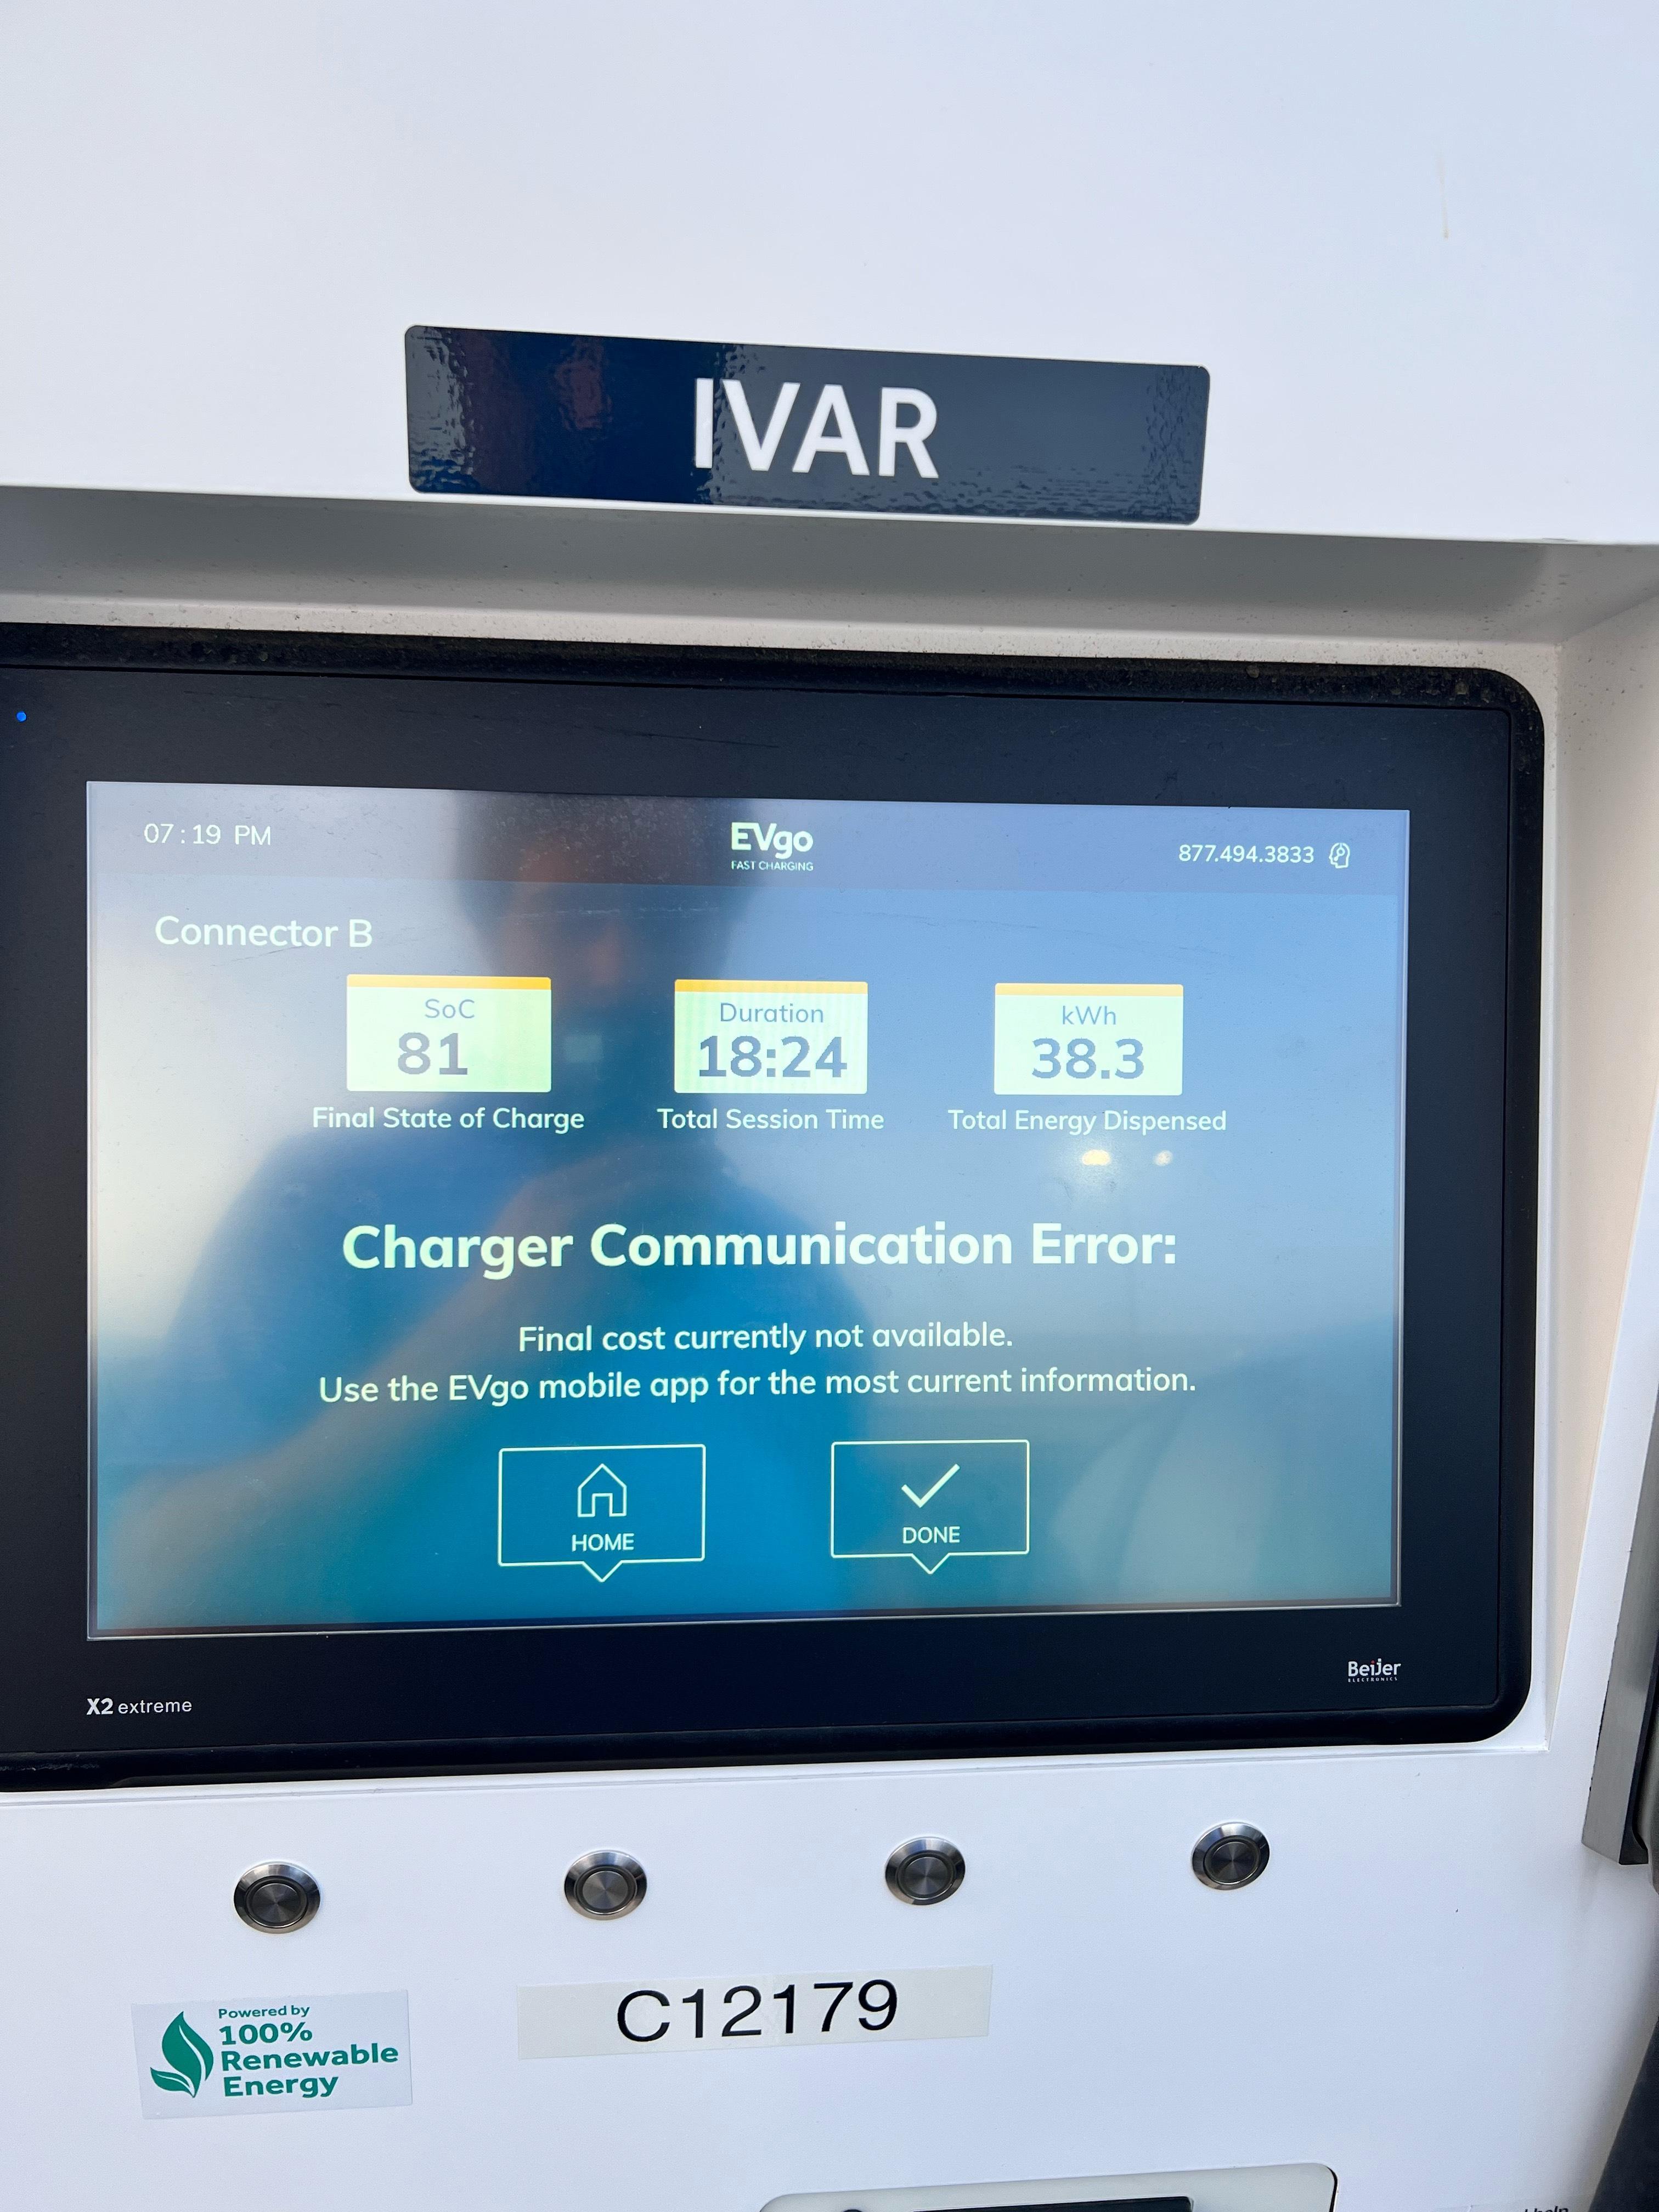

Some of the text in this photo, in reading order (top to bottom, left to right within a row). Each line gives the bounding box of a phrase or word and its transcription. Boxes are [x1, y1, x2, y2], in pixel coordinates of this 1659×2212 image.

[693, 376, 939, 479] IVAR
[234, 825, 272, 847] PM
[731, 822, 814, 859] EVgo
[731, 860, 814, 871] FAST CHARGING
[1178, 844, 1314, 864] 877.494.3833
[155, 916, 373, 948] Connector B
[424, 998, 476, 1019] SoC
[719, 1001, 825, 1024] Duration
[1062, 1005, 1117, 1026] kWh
[397, 1032, 468, 1075] 81
[698, 1036, 848, 1079] 18:24
[1032, 1038, 1146, 1080] 38.3
[313, 1107, 585, 1134] Final State of Charge
[657, 1108, 884, 1130] Total Session Time
[949, 1109, 1227, 1136] Total Energy Dispensed
[342, 1221, 1176, 1280] Charger Communication Error:
[520, 1322, 1013, 1355] Final cost currently not available.
[319, 1366, 1196, 1407] Use the EVgo mobile app for the most current information.
[571, 1533, 634, 1551] HOME
[902, 1526, 961, 1544] DONE
[1348, 1658, 1401, 1677] Beijer
[87, 1697, 192, 1715] X2 extreme
[219, 2005, 309, 2019] Powered by
[617, 1979, 898, 2042] C12179
[219, 2022, 313, 2045] 100%
[222, 2042, 398, 2071] Renewable
[223, 2076, 338, 2098] Energy
